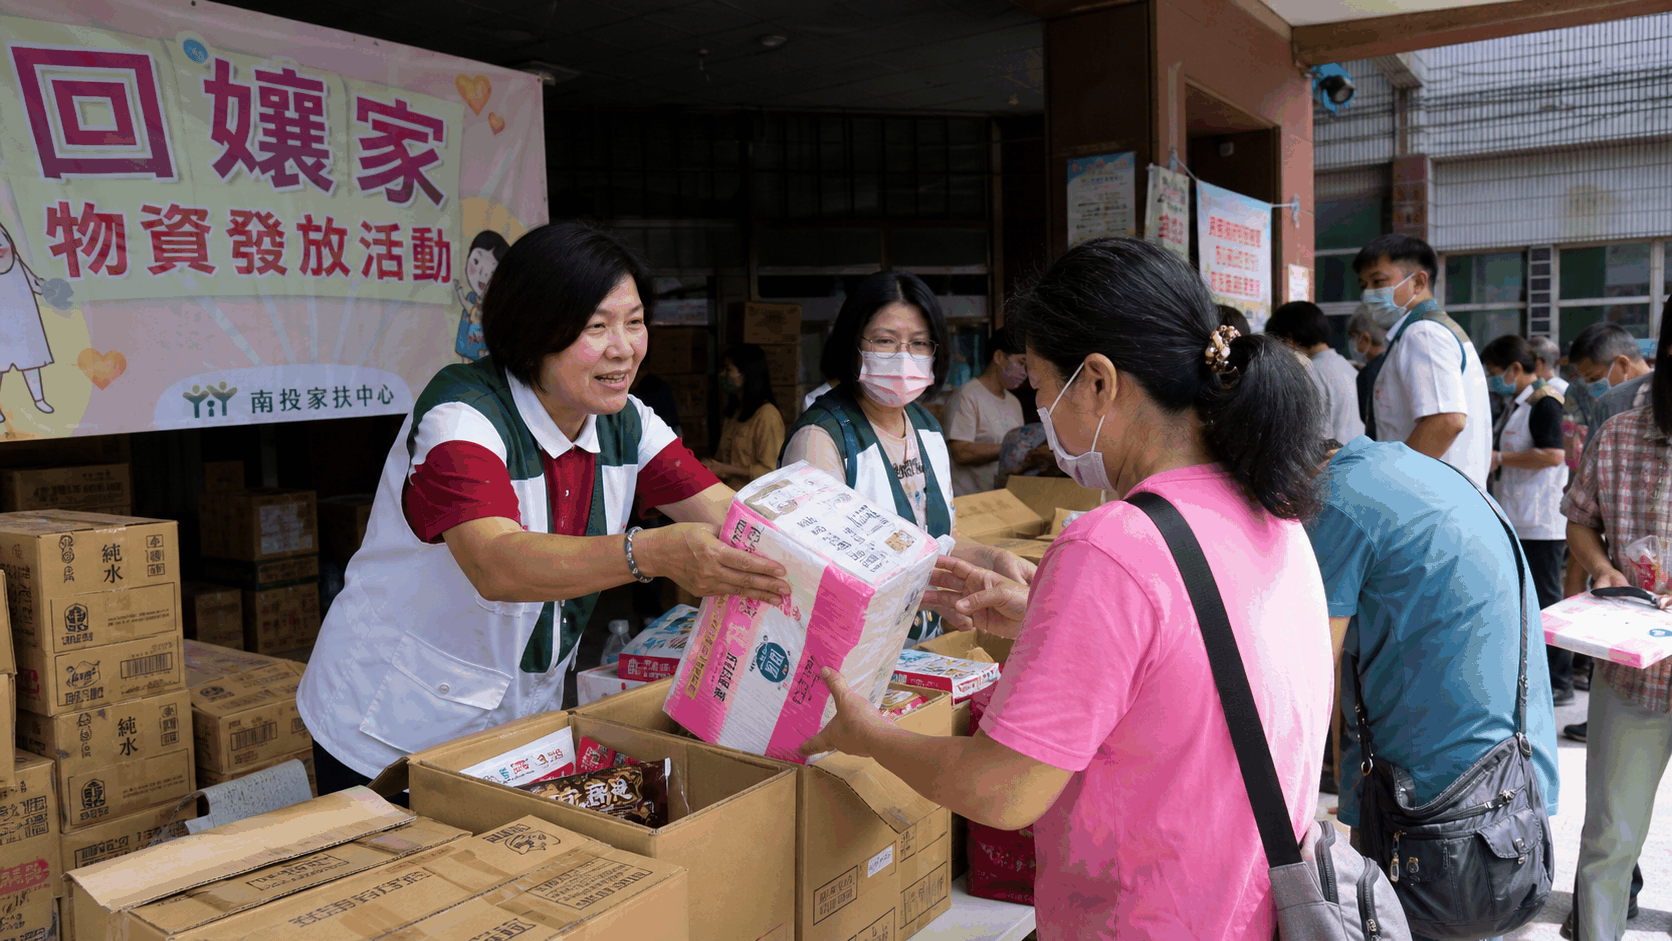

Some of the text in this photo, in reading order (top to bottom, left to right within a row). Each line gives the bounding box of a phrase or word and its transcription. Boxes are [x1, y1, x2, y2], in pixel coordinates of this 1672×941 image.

[10, 46, 445, 207] 回孃家
[46, 201, 452, 283] 物資發放活動
[250, 383, 395, 414] 南投家扶中心
[101, 543, 124, 584] 純水
[117, 716, 138, 757] 純水
